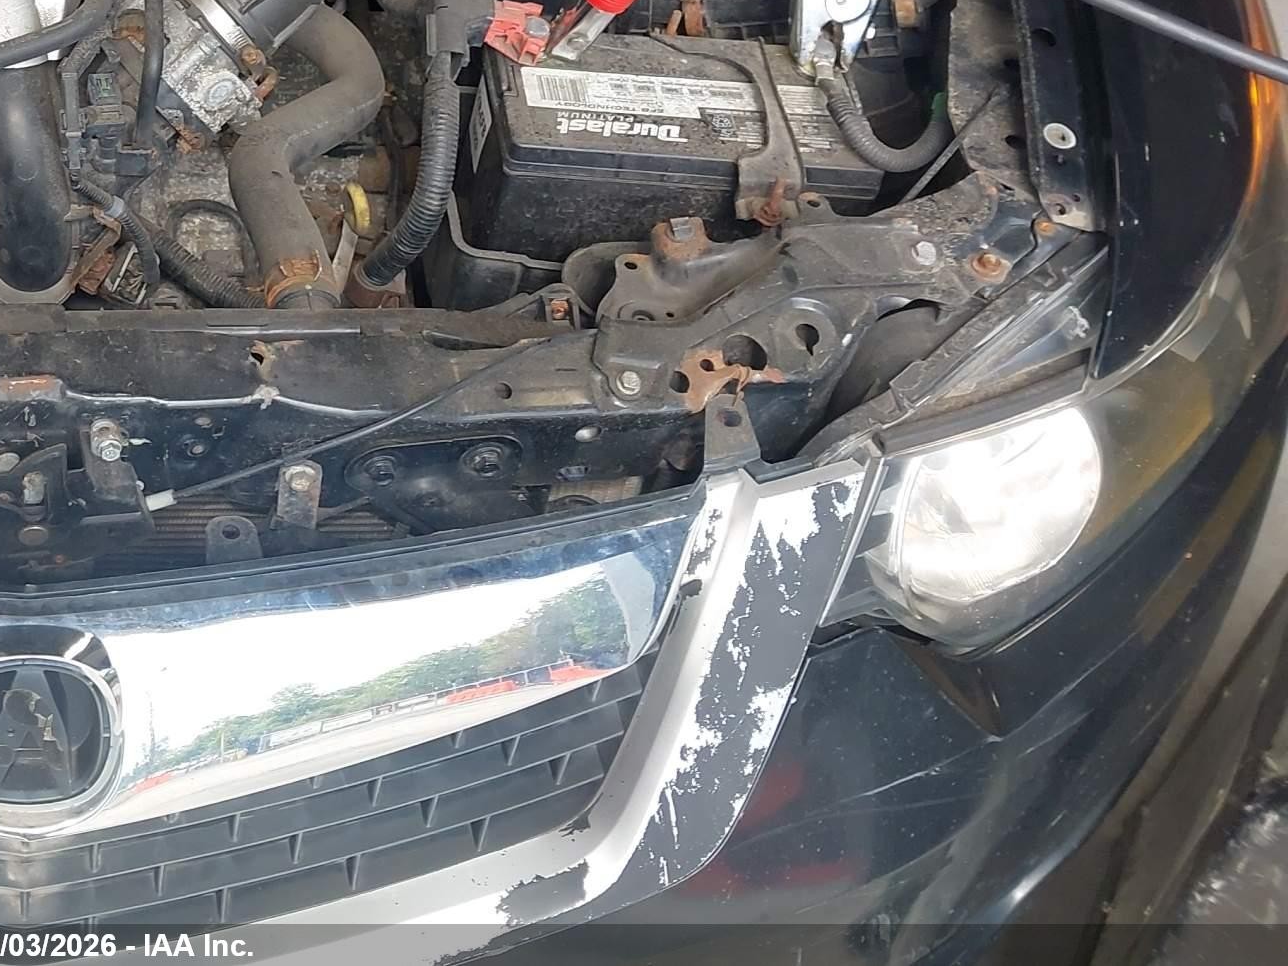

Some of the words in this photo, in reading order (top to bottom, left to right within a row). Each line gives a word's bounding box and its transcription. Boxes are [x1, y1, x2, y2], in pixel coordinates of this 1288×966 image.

[554, 101, 636, 112] TECHNOLOGY
[557, 111, 635, 123] PLATINUM
[556, 117, 689, 143] Duralast
